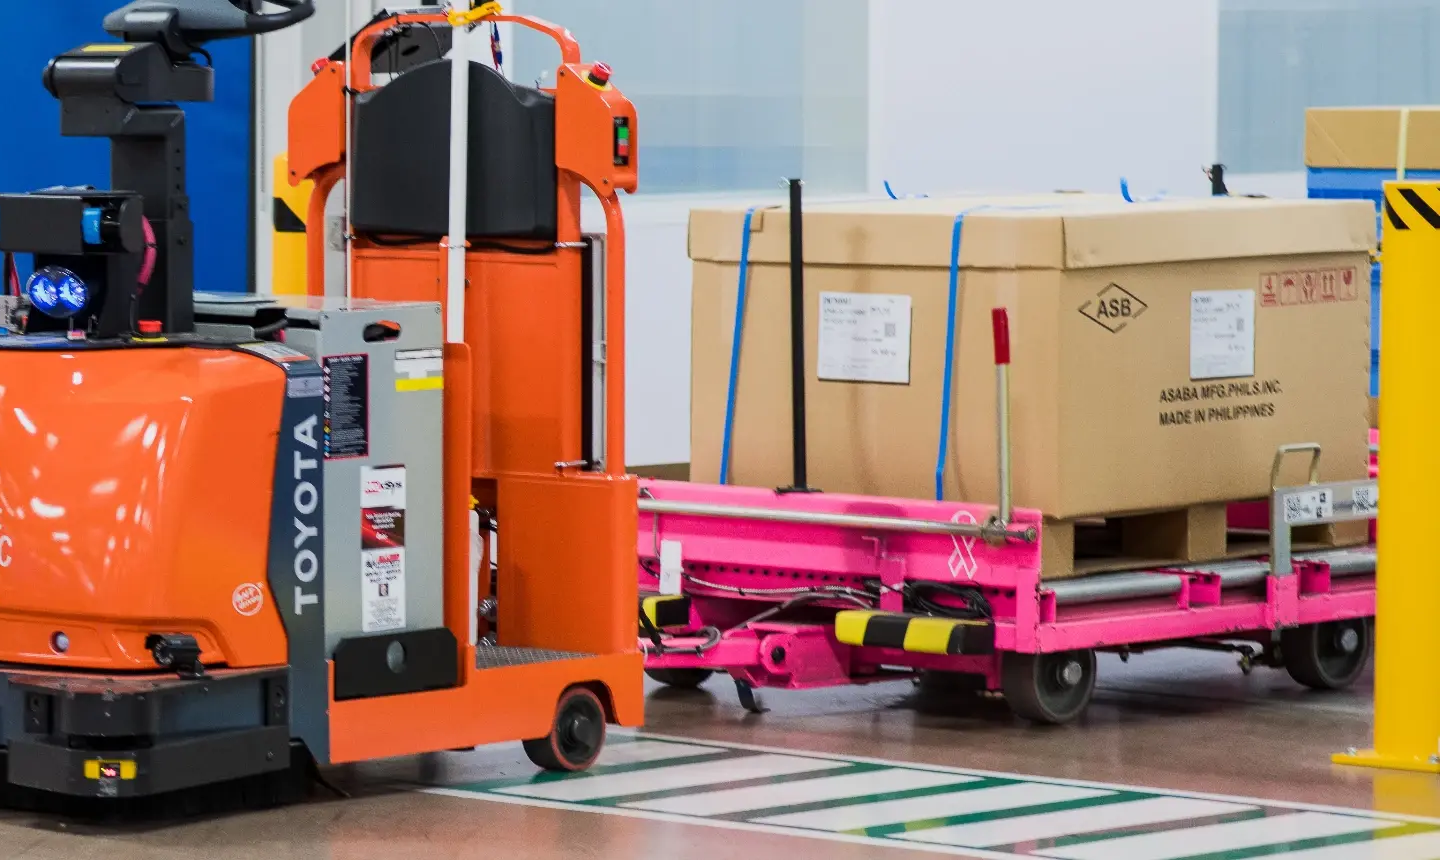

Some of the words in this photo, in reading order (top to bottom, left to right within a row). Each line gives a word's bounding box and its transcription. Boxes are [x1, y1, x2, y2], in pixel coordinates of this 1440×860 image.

[1097, 298, 1131, 318] ASB
[1160, 387, 1198, 402] ASABA
[1159, 409, 1192, 425] MADE
[1194, 408, 1205, 423] IN
[1208, 403, 1275, 421] PHILIPPINES
[293, 413, 318, 615] TOYOTA
